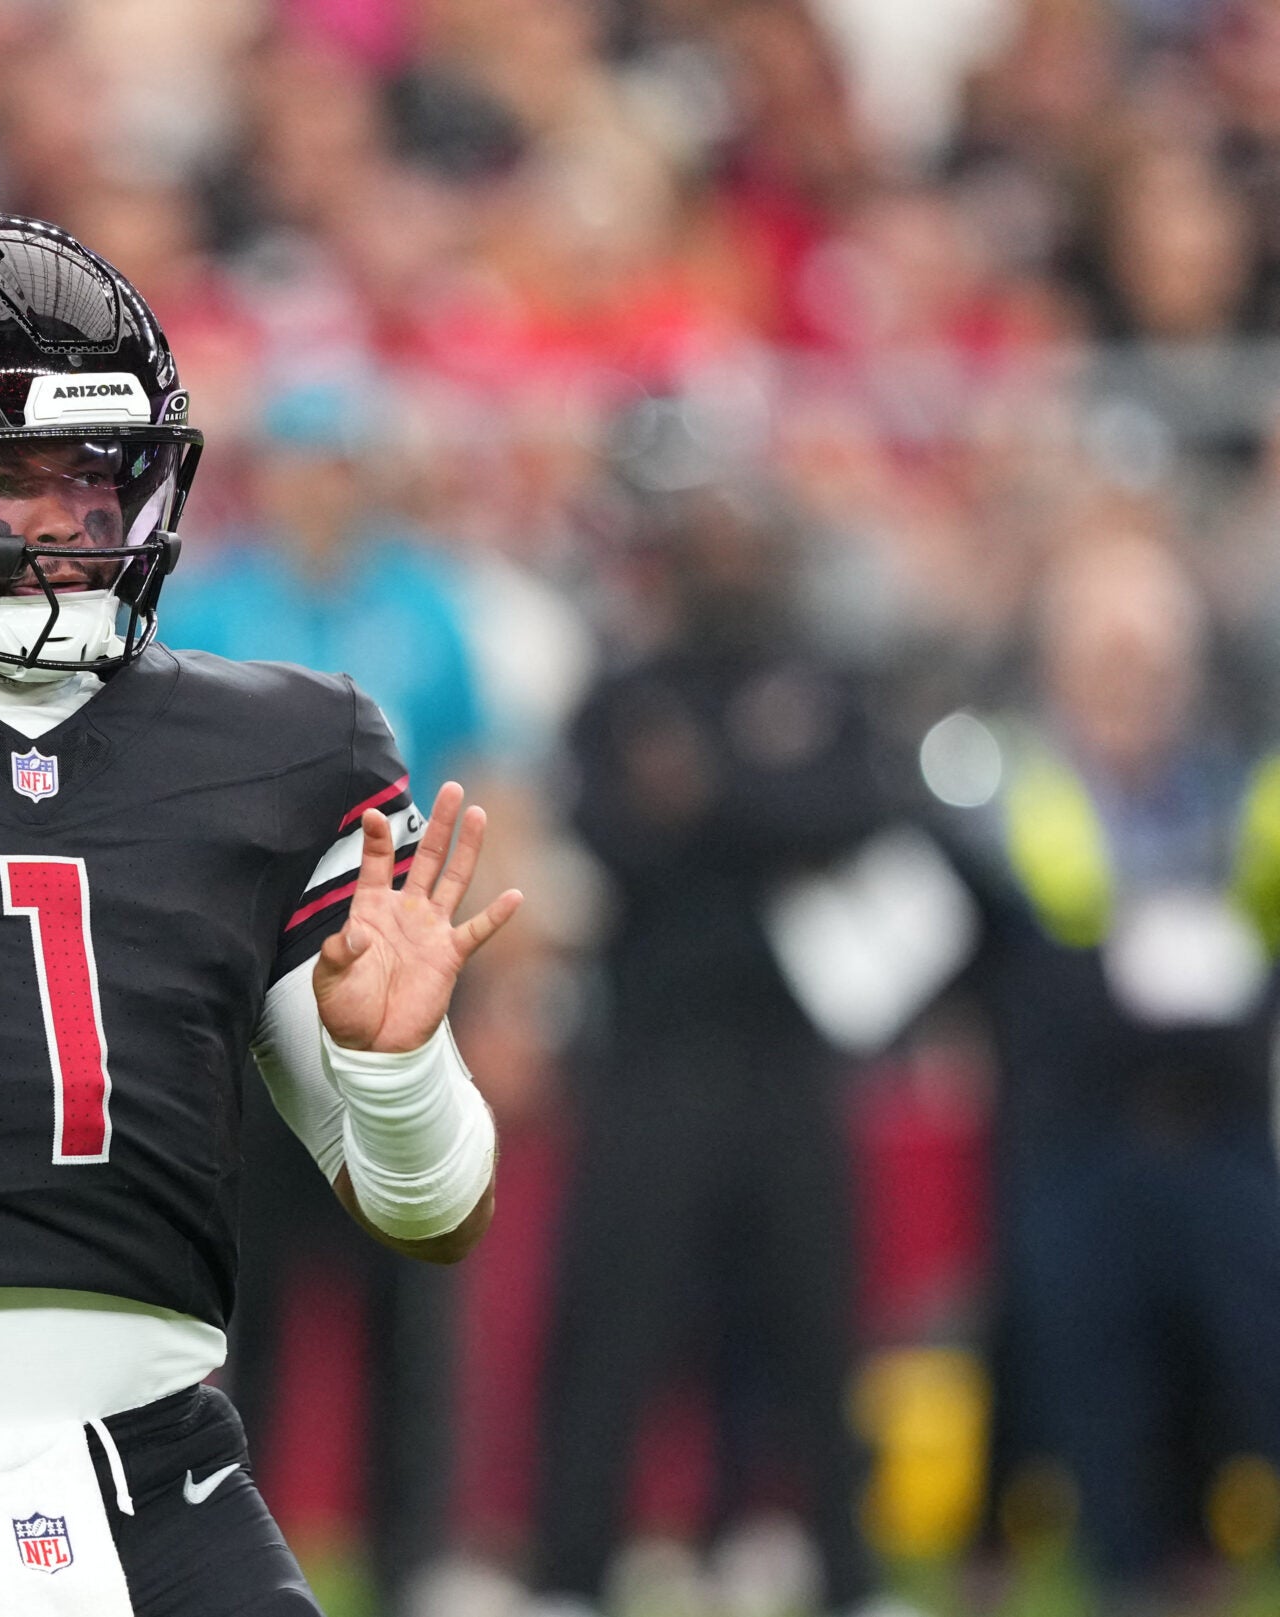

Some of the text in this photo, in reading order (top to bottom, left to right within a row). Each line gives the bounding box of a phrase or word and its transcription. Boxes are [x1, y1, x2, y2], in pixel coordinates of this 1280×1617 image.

[53, 384, 133, 399] ARIZONA
[165, 411, 188, 422] OAKLEY
[19, 770, 52, 791] NFL
[22, 1538, 67, 1567] NFL
